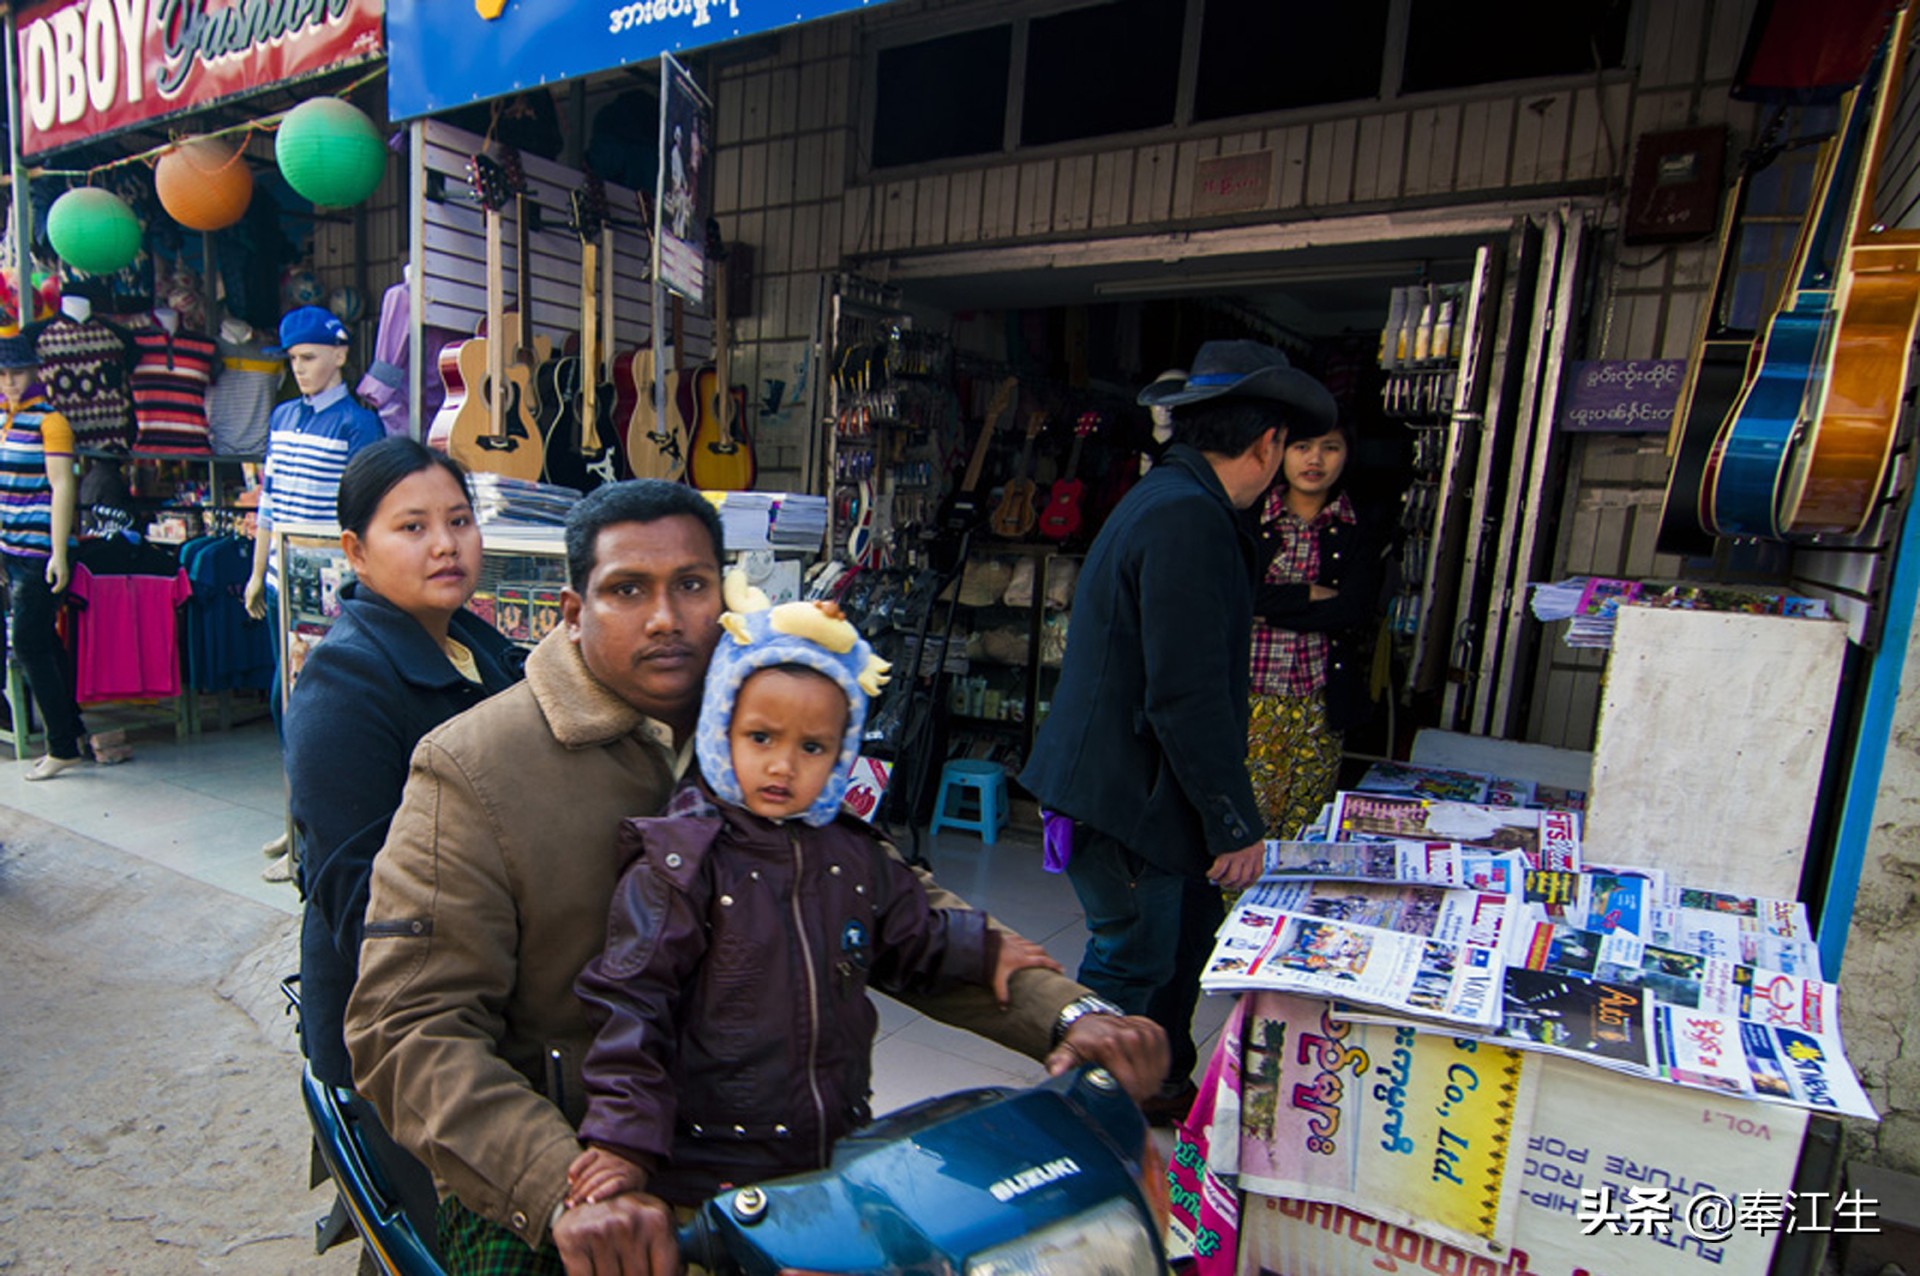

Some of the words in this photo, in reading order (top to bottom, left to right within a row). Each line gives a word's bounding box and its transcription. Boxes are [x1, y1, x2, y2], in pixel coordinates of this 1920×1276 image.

[27, 0, 147, 132] OBOY
[156, 0, 349, 101] Fashion
[1599, 985, 1638, 1025] Auto
[1436, 1063, 1479, 1117] Co.,
[1702, 1109, 1772, 1141] VOL.1
[988, 1155, 1083, 1203] SUZUKI
[1432, 1126, 1469, 1185] Ltd.
